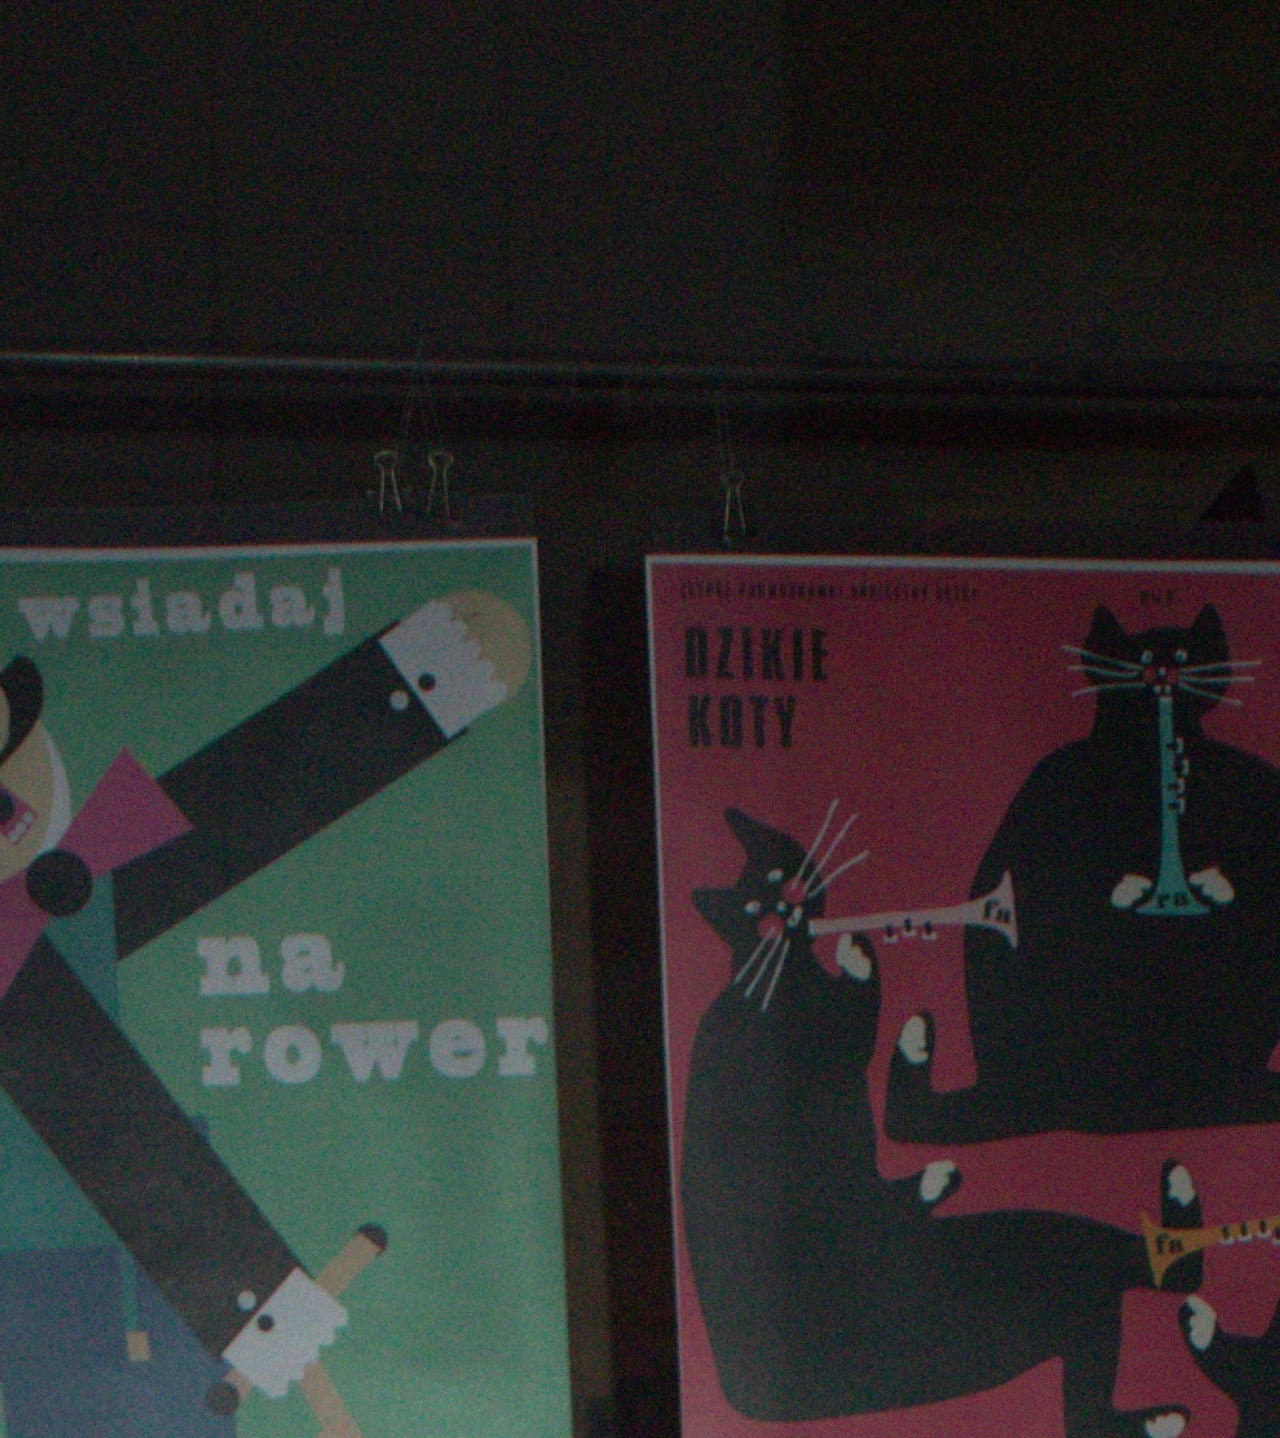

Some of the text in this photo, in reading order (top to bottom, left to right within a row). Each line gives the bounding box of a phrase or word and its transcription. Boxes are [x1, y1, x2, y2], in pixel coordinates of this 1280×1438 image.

[17, 567, 347, 639] wsiadaj
[684, 626, 829, 684] DZIKIE
[688, 693, 796, 749] KOTY
[195, 929, 346, 998] na
[199, 1013, 548, 1088] rower
